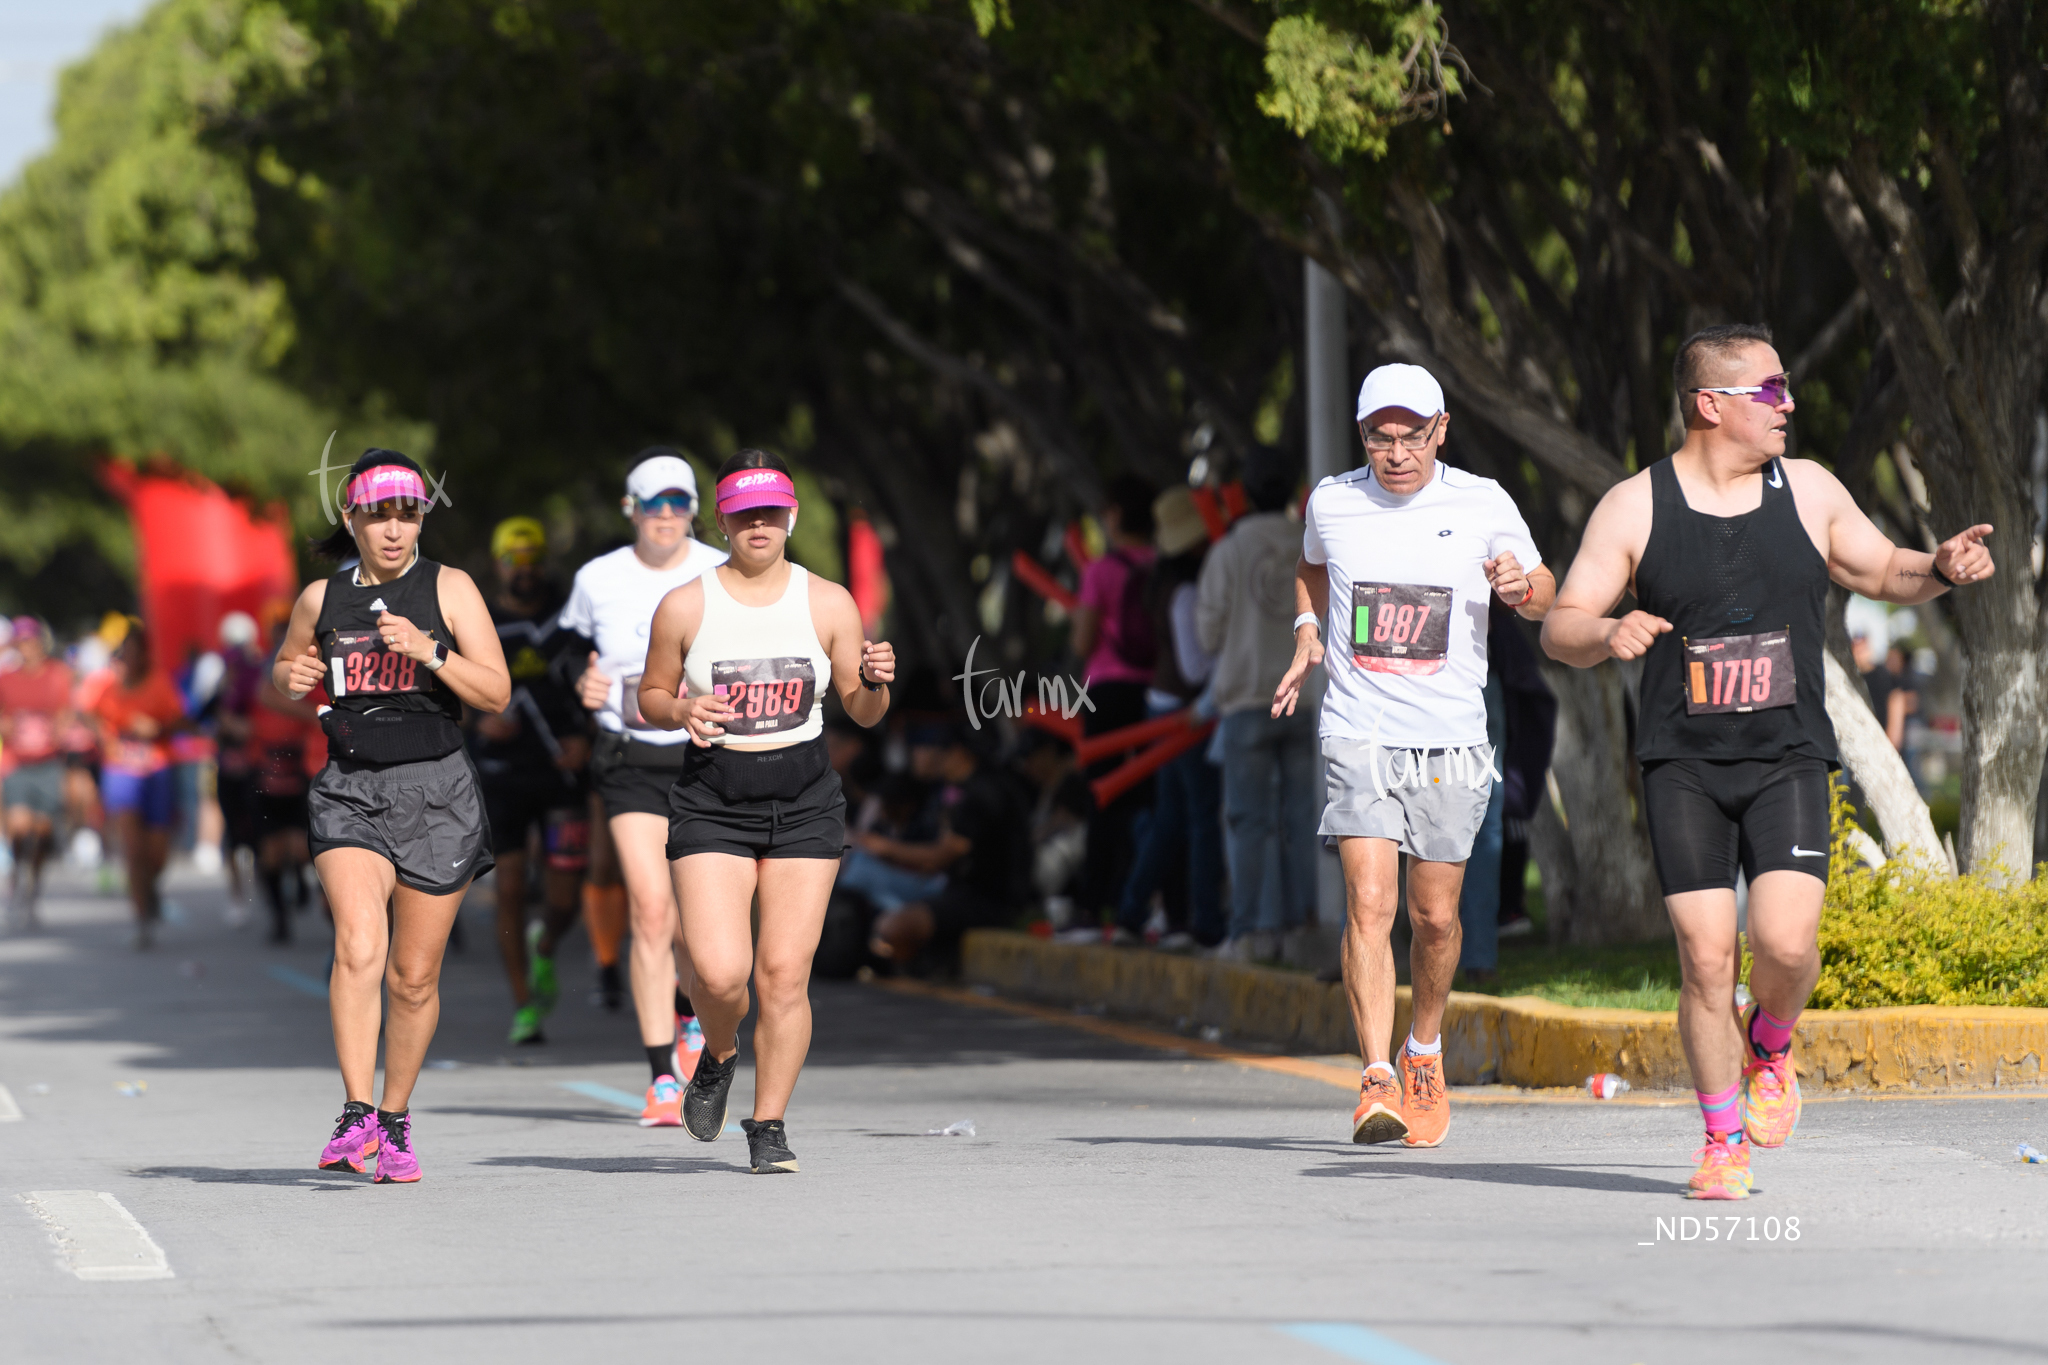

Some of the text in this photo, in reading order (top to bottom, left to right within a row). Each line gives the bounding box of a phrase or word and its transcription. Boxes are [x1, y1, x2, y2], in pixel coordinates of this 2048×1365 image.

[1373, 603, 1432, 644] 987
[346, 651, 417, 692] 3288
[1712, 656, 1772, 705] 1713
[729, 677, 803, 719] 2989
[756, 753, 784, 763] REXCHI
